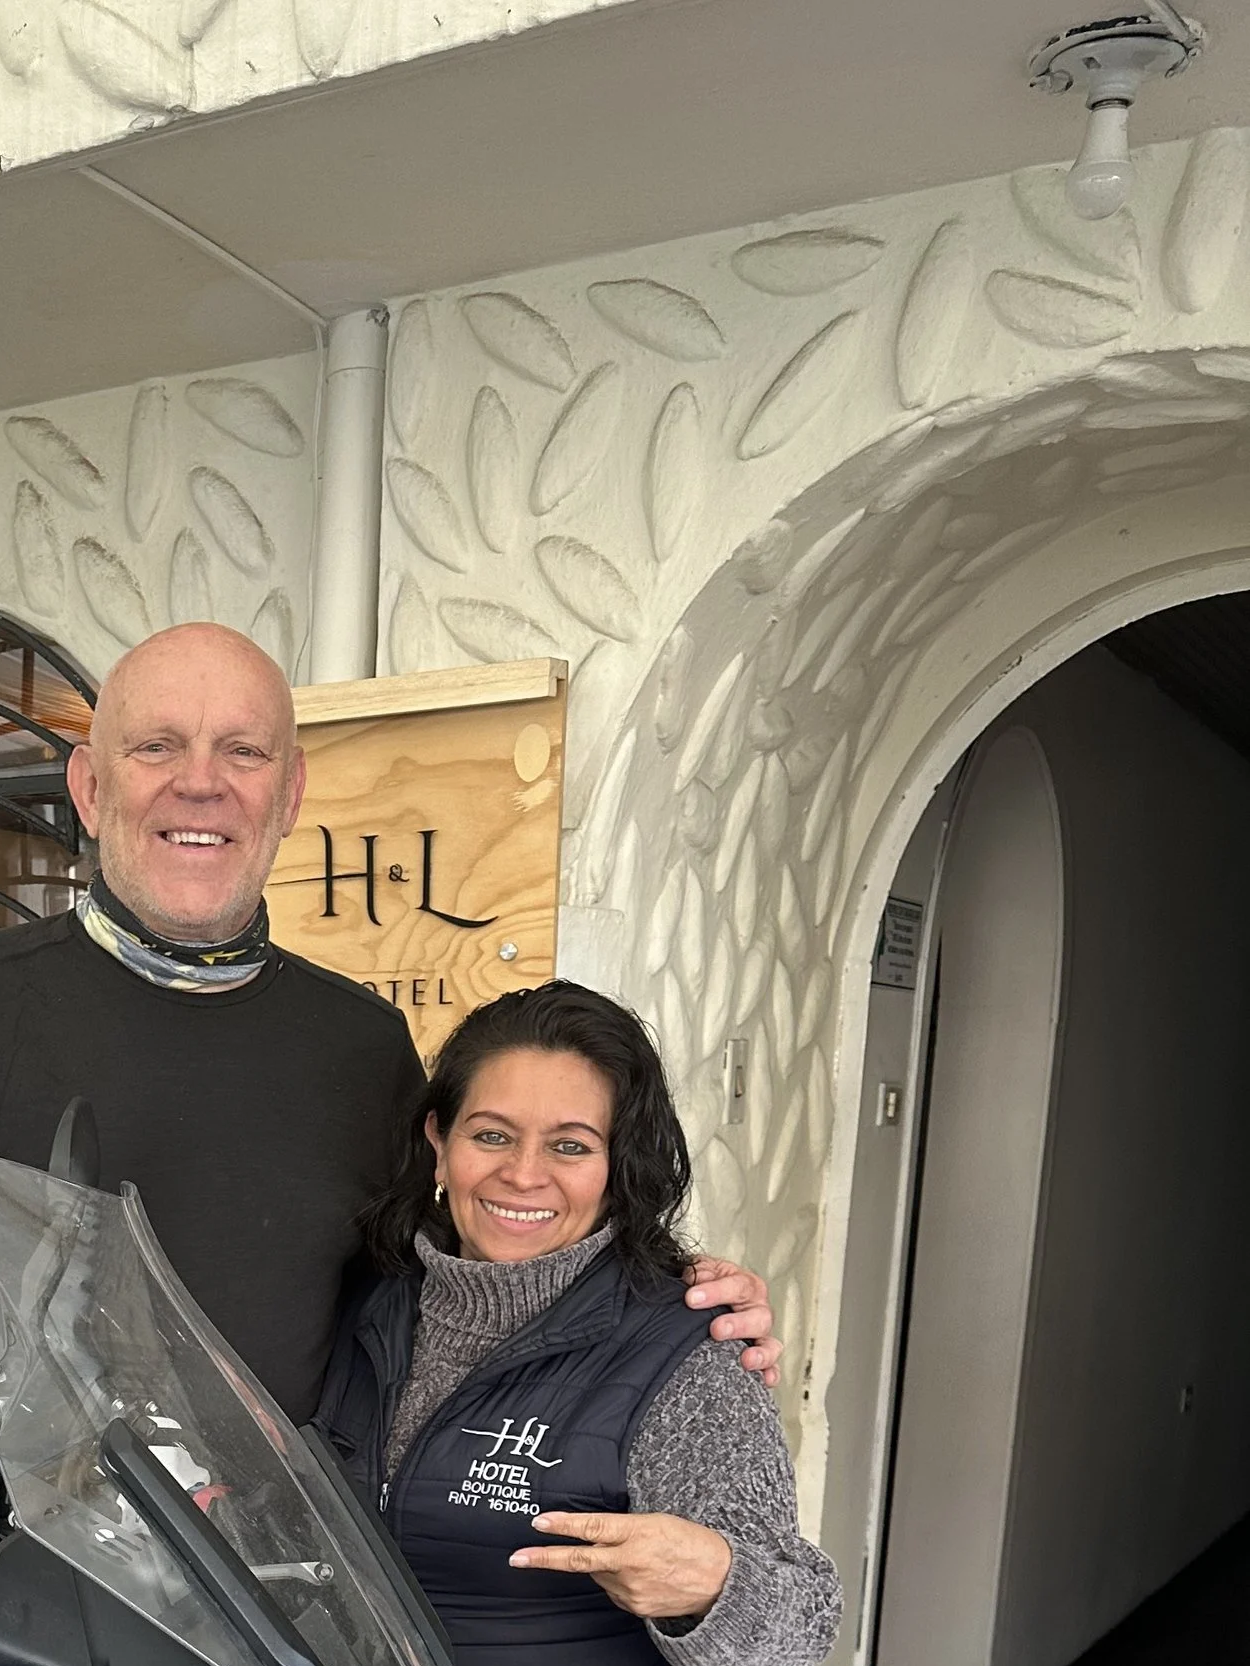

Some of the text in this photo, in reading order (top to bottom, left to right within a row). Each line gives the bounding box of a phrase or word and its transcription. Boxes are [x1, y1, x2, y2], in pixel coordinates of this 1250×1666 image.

[468, 1459, 531, 1487] HOTEL
[447, 1490, 540, 1517] RNT 161040
[461, 1480, 532, 1502] BOUTIQUE
